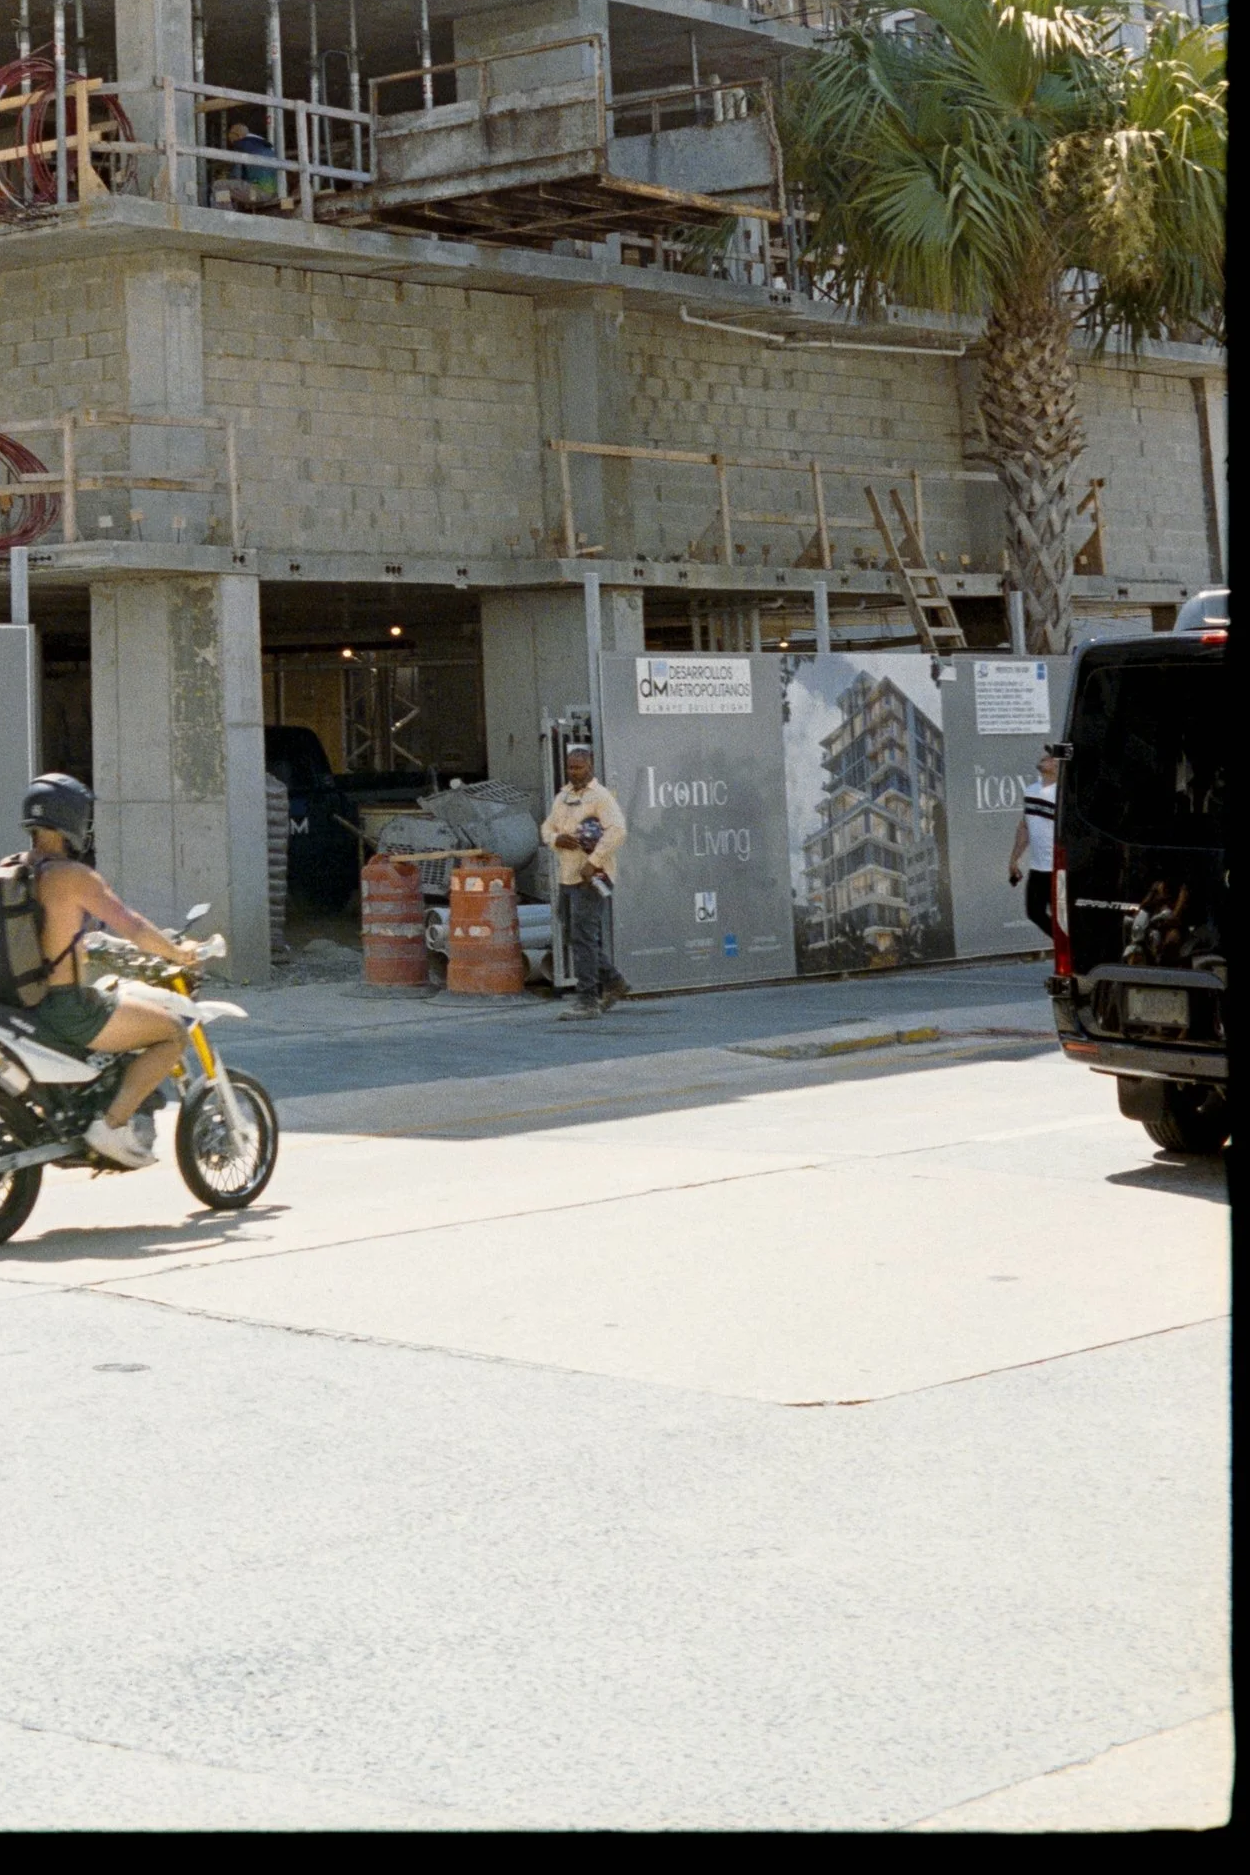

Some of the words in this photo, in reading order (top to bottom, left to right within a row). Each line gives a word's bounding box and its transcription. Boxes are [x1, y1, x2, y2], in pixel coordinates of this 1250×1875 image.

[669, 665, 733, 680] DESARROLLOS
[670, 683, 750, 697] METROPOLITANOS
[647, 766, 728, 808] Iconic
[692, 824, 750, 861] Living
